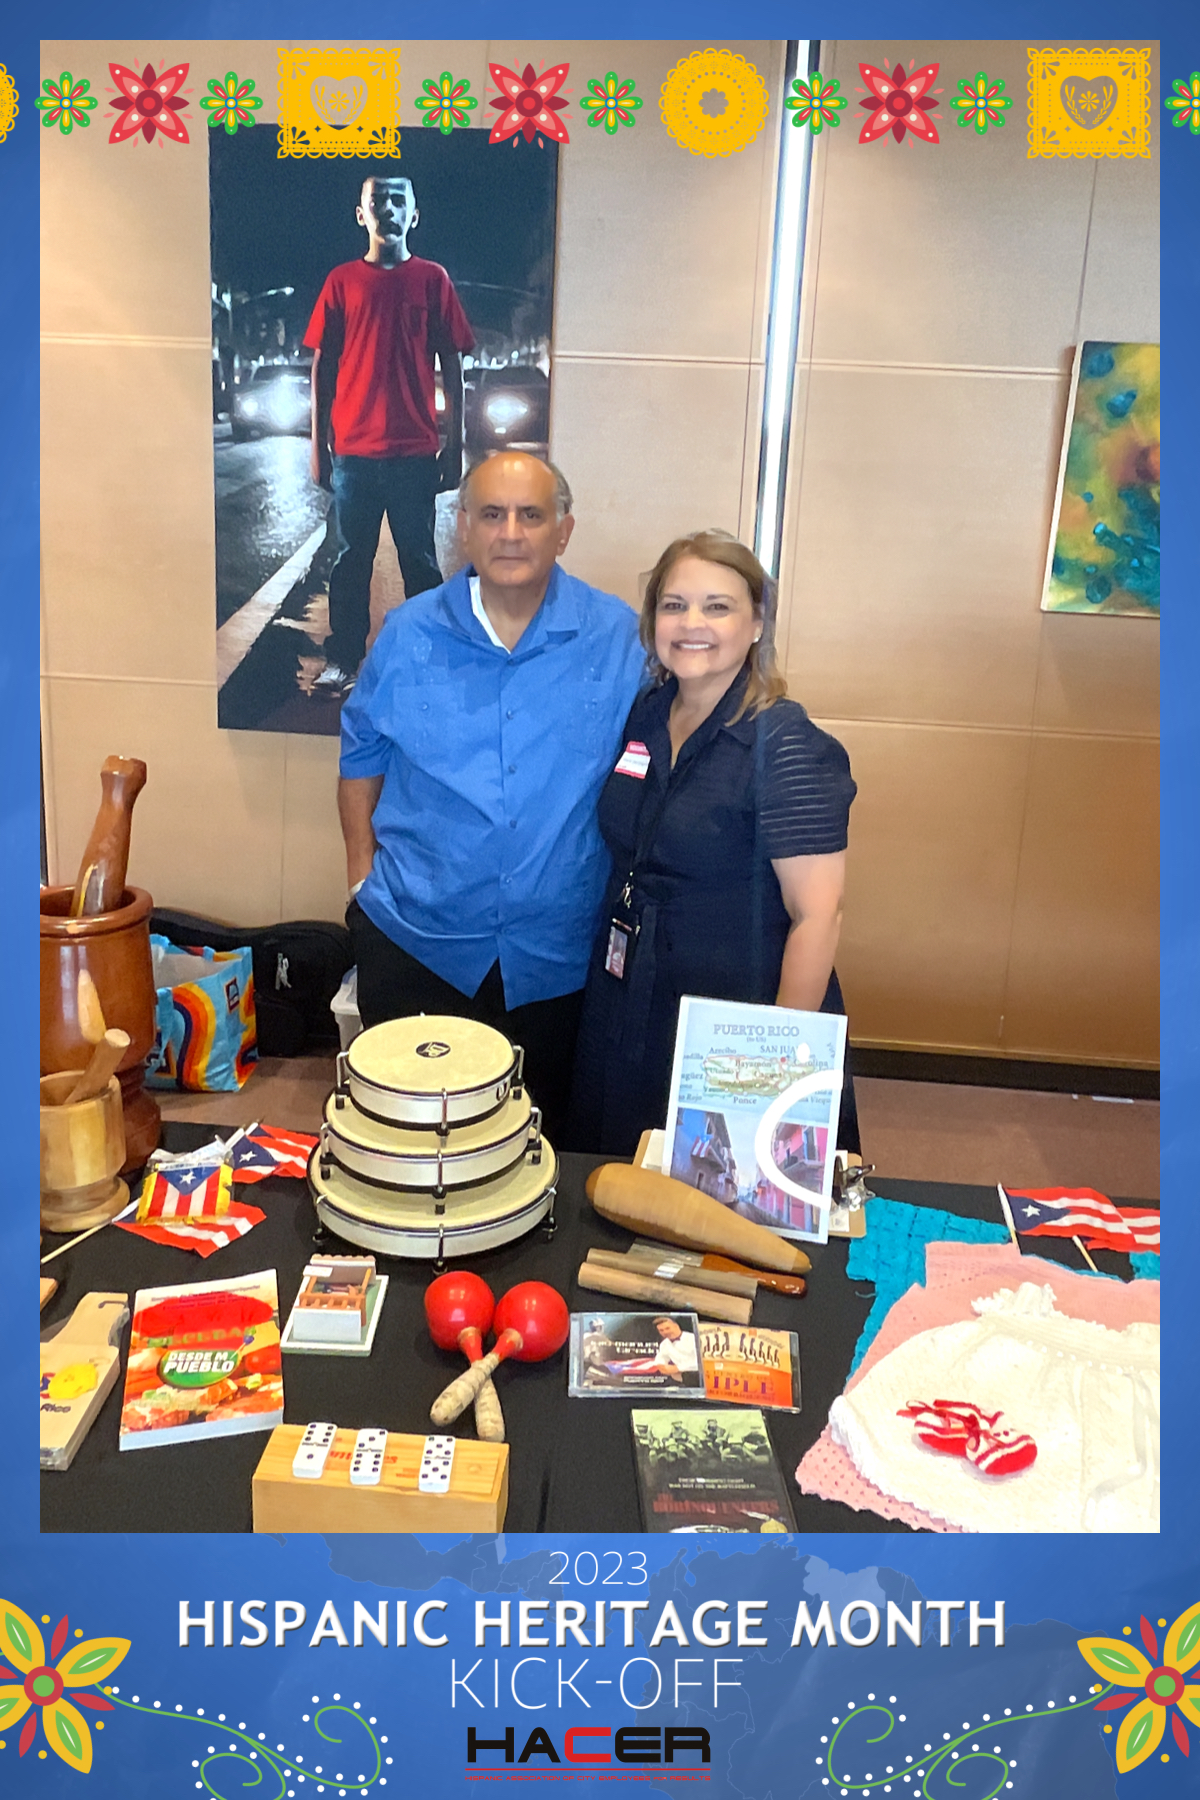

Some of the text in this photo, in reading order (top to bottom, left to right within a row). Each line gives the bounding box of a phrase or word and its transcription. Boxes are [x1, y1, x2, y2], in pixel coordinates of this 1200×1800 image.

[713, 1023, 800, 1037] PUERTO RICO
[760, 1045, 799, 1055] SAN JUA
[733, 1096, 757, 1105] Ponce
[168, 1351, 212, 1362] DESDE
[163, 1360, 235, 1374] PUEBLO
